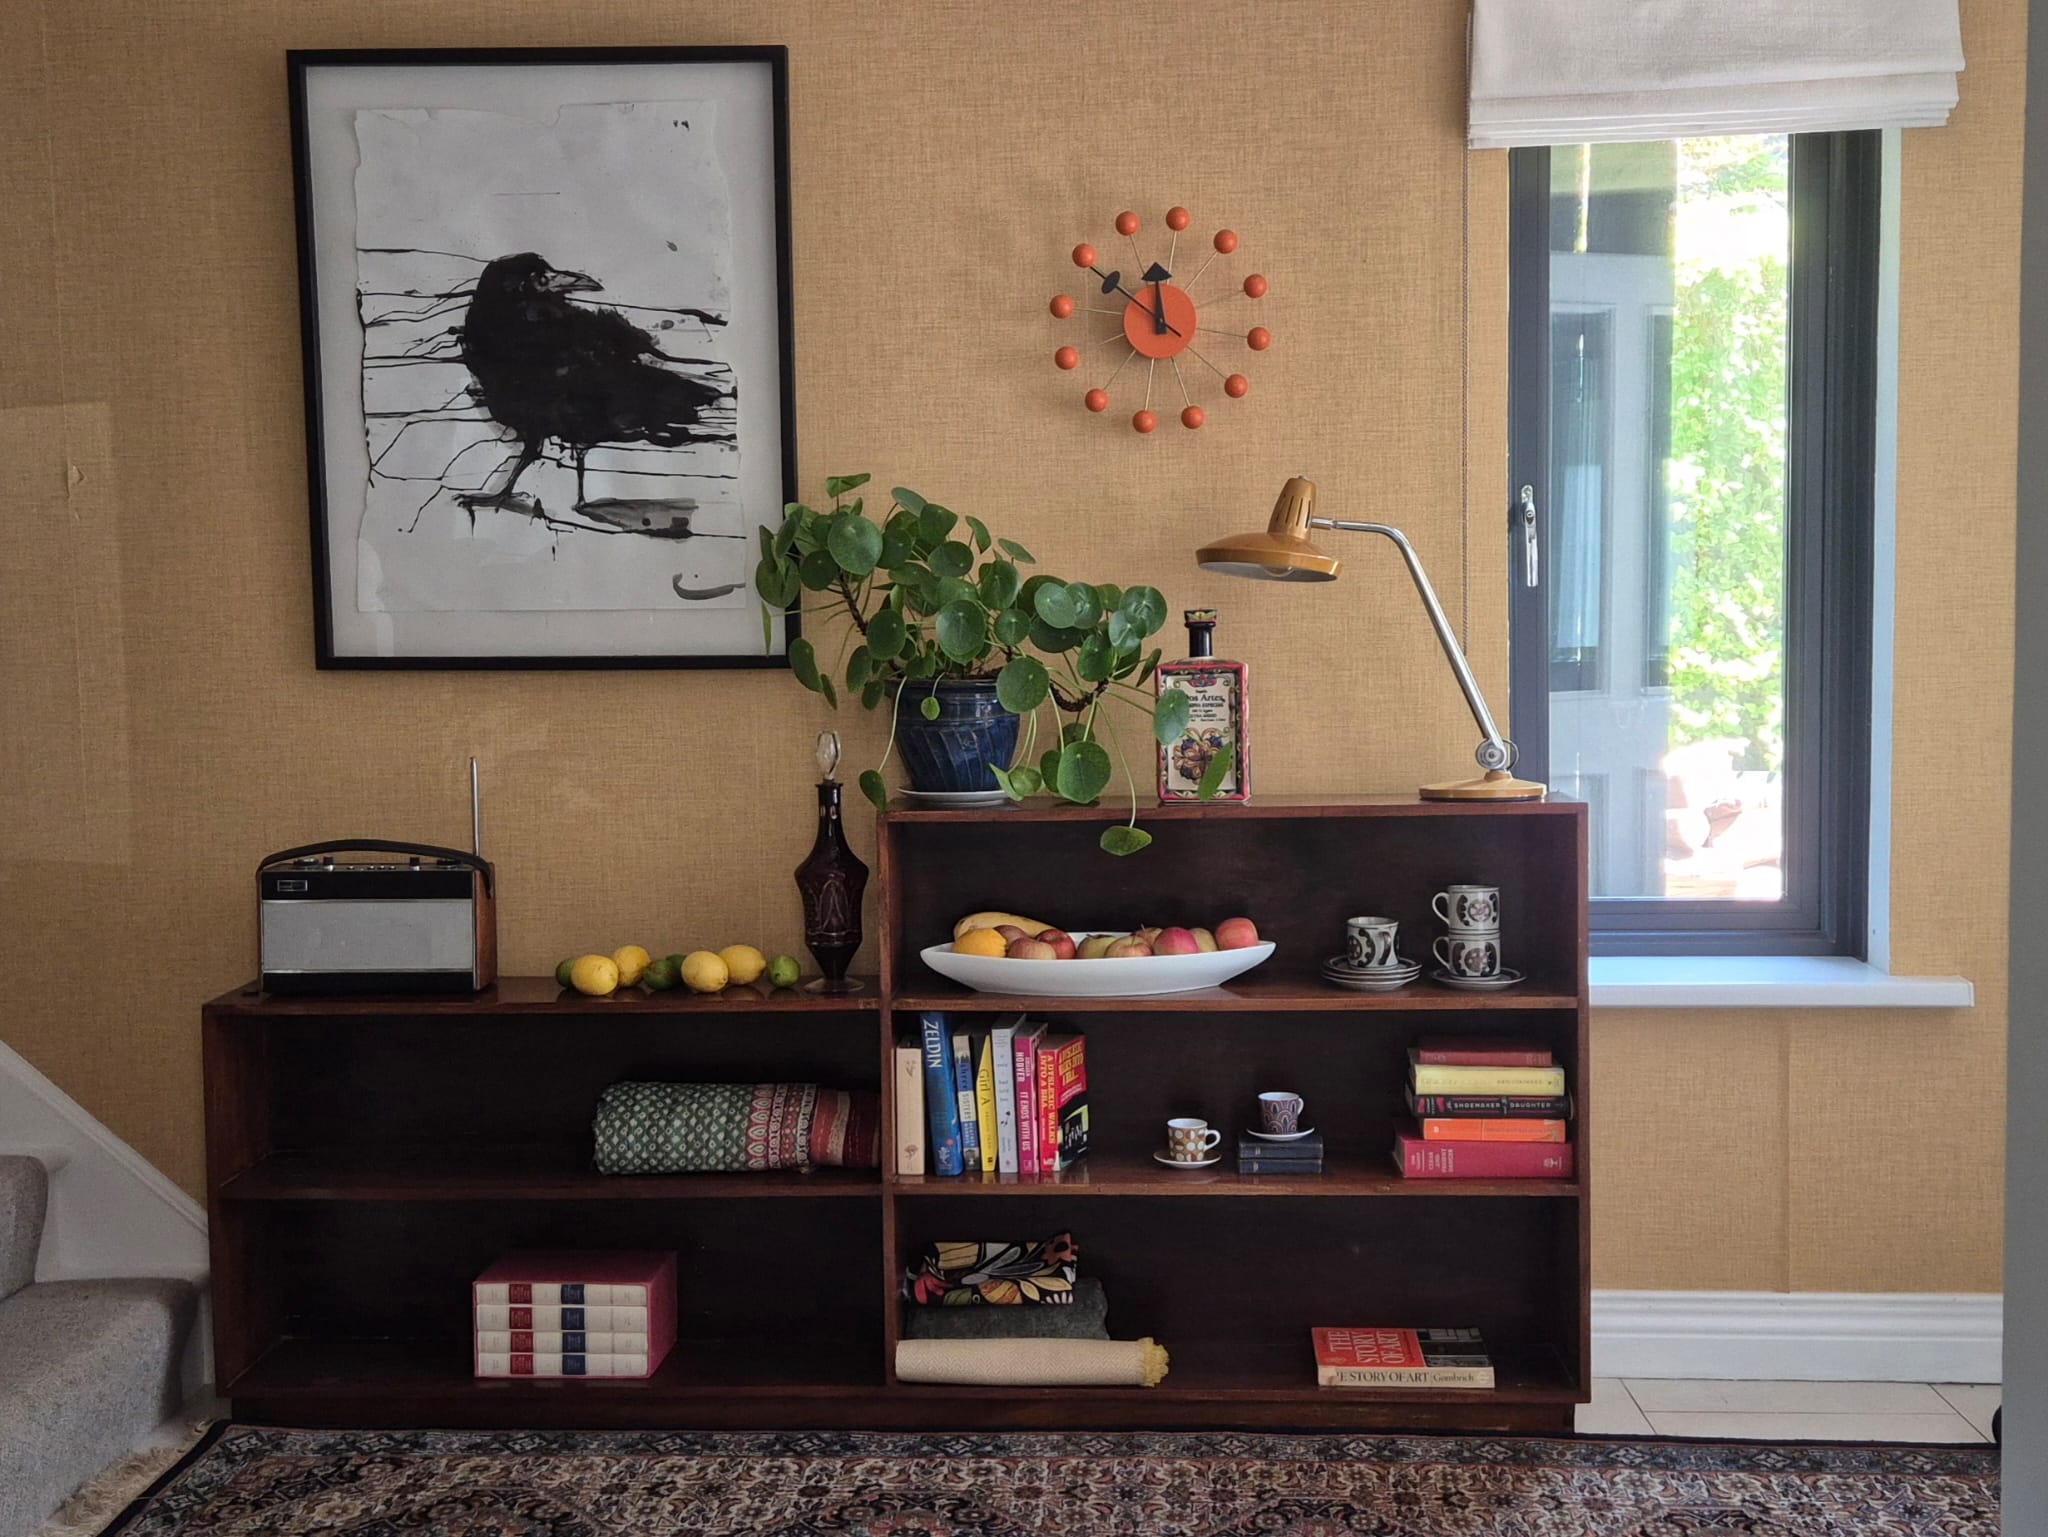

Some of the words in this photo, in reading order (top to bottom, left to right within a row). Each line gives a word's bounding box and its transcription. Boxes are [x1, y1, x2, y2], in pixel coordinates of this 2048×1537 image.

[923, 1019, 943, 1068] ZELDIN
[1015, 1051, 1025, 1082] HOOVER
[978, 1068, 990, 1092] Girl
[1047, 1064, 1056, 1109] DYSLEXIC
[981, 1096, 991, 1106] A
[1020, 1100, 1029, 1120] ENDS
[1021, 1120, 1031, 1140] WITH
[1022, 1141, 1031, 1151] US
[1327, 1330, 1353, 1352] THE
[1351, 1331, 1381, 1364] STORY
[1376, 1331, 1403, 1352] ART
[1380, 1350, 1406, 1364] OF
[1349, 1371, 1388, 1383] STORY
[1388, 1371, 1406, 1383] OF
[1406, 1371, 1429, 1383] ART
[1432, 1372, 1474, 1382] Gombrich
